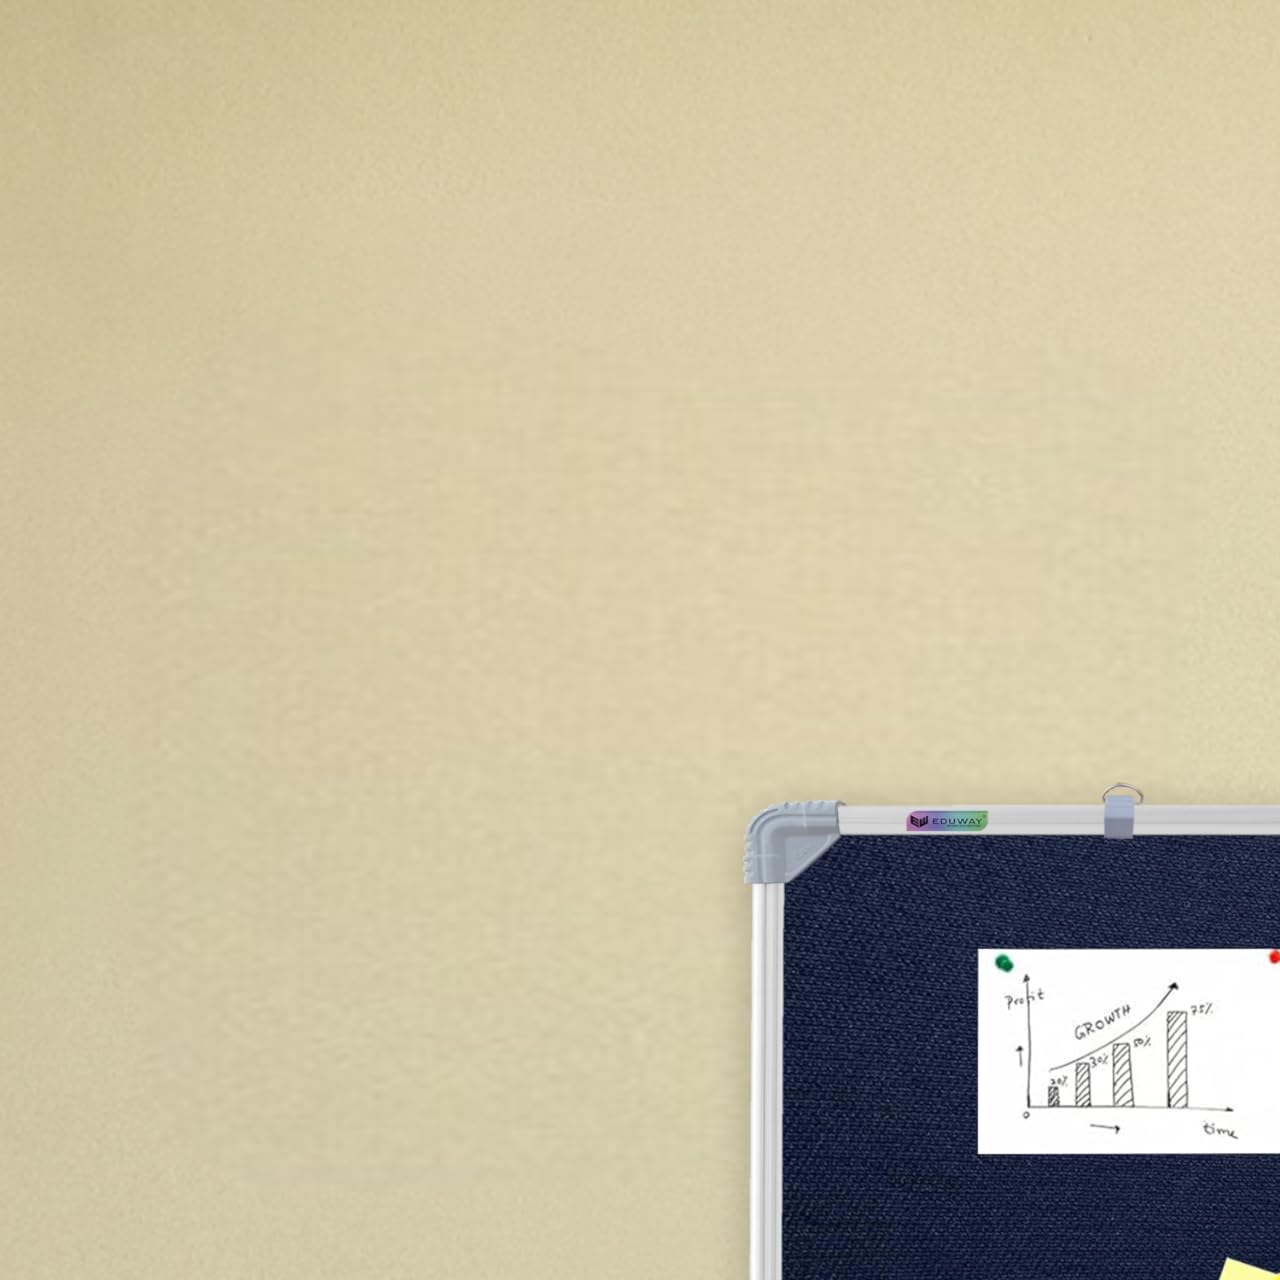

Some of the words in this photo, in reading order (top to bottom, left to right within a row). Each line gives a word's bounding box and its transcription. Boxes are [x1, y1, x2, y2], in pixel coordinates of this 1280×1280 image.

[932, 817, 982, 826] EDUWAY
[1004, 987, 1046, 1009] Profit
[1190, 1002, 1216, 1016] 75%
[1074, 1004, 1132, 1041] GROWTH
[1133, 1034, 1152, 1049] 50%
[1203, 1120, 1238, 1139] time
